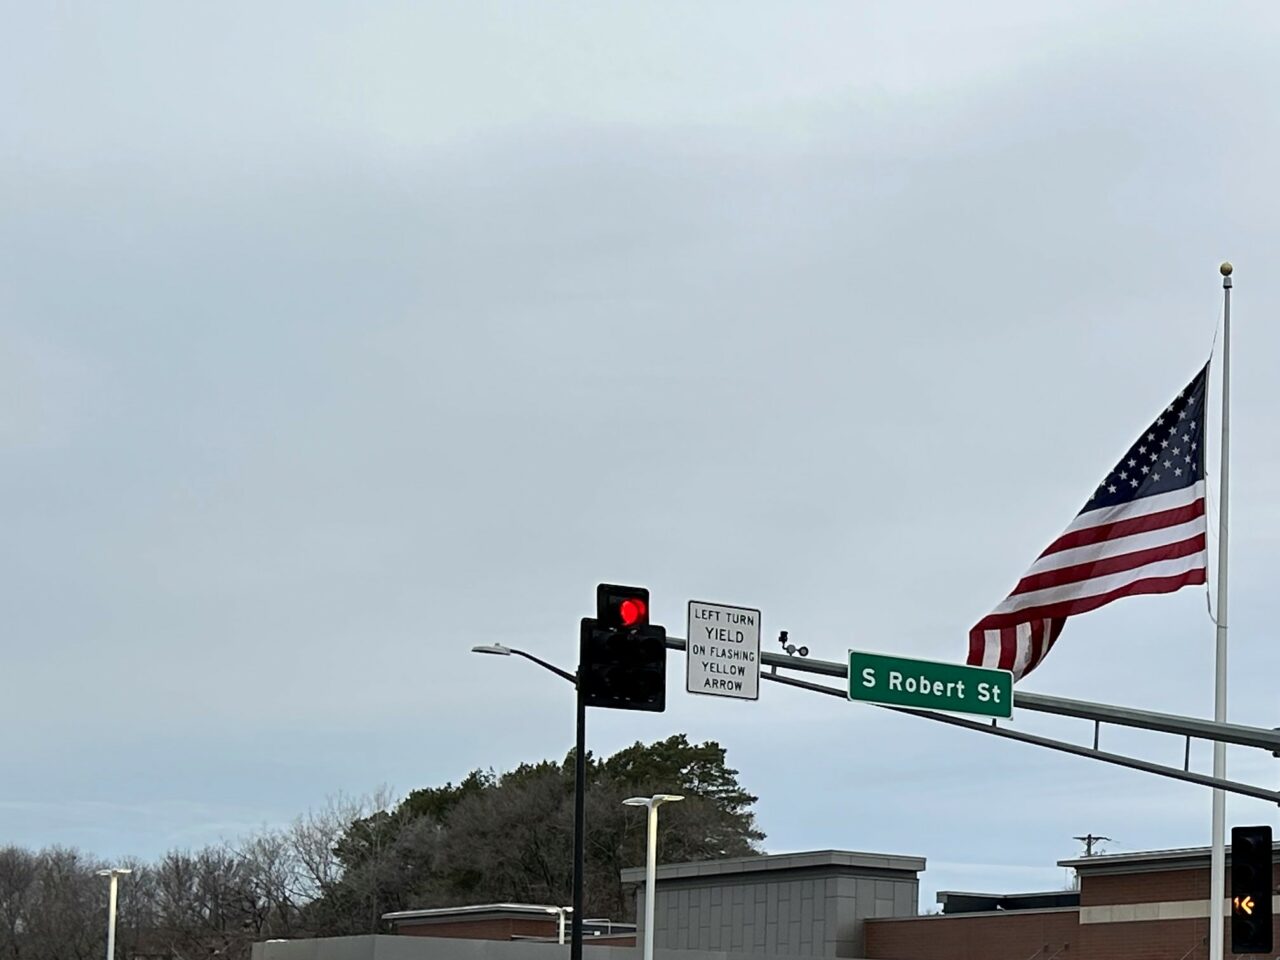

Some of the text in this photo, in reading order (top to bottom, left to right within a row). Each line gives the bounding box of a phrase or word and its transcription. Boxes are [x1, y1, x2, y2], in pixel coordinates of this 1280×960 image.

[695, 608, 754, 626] LEFT TURN
[705, 626, 744, 643] YIELD
[692, 644, 754, 662] ON FLASHING
[701, 661, 745, 676] YELLOW
[703, 677, 742, 692] ARROW
[862, 668, 1001, 703] S Robert St
